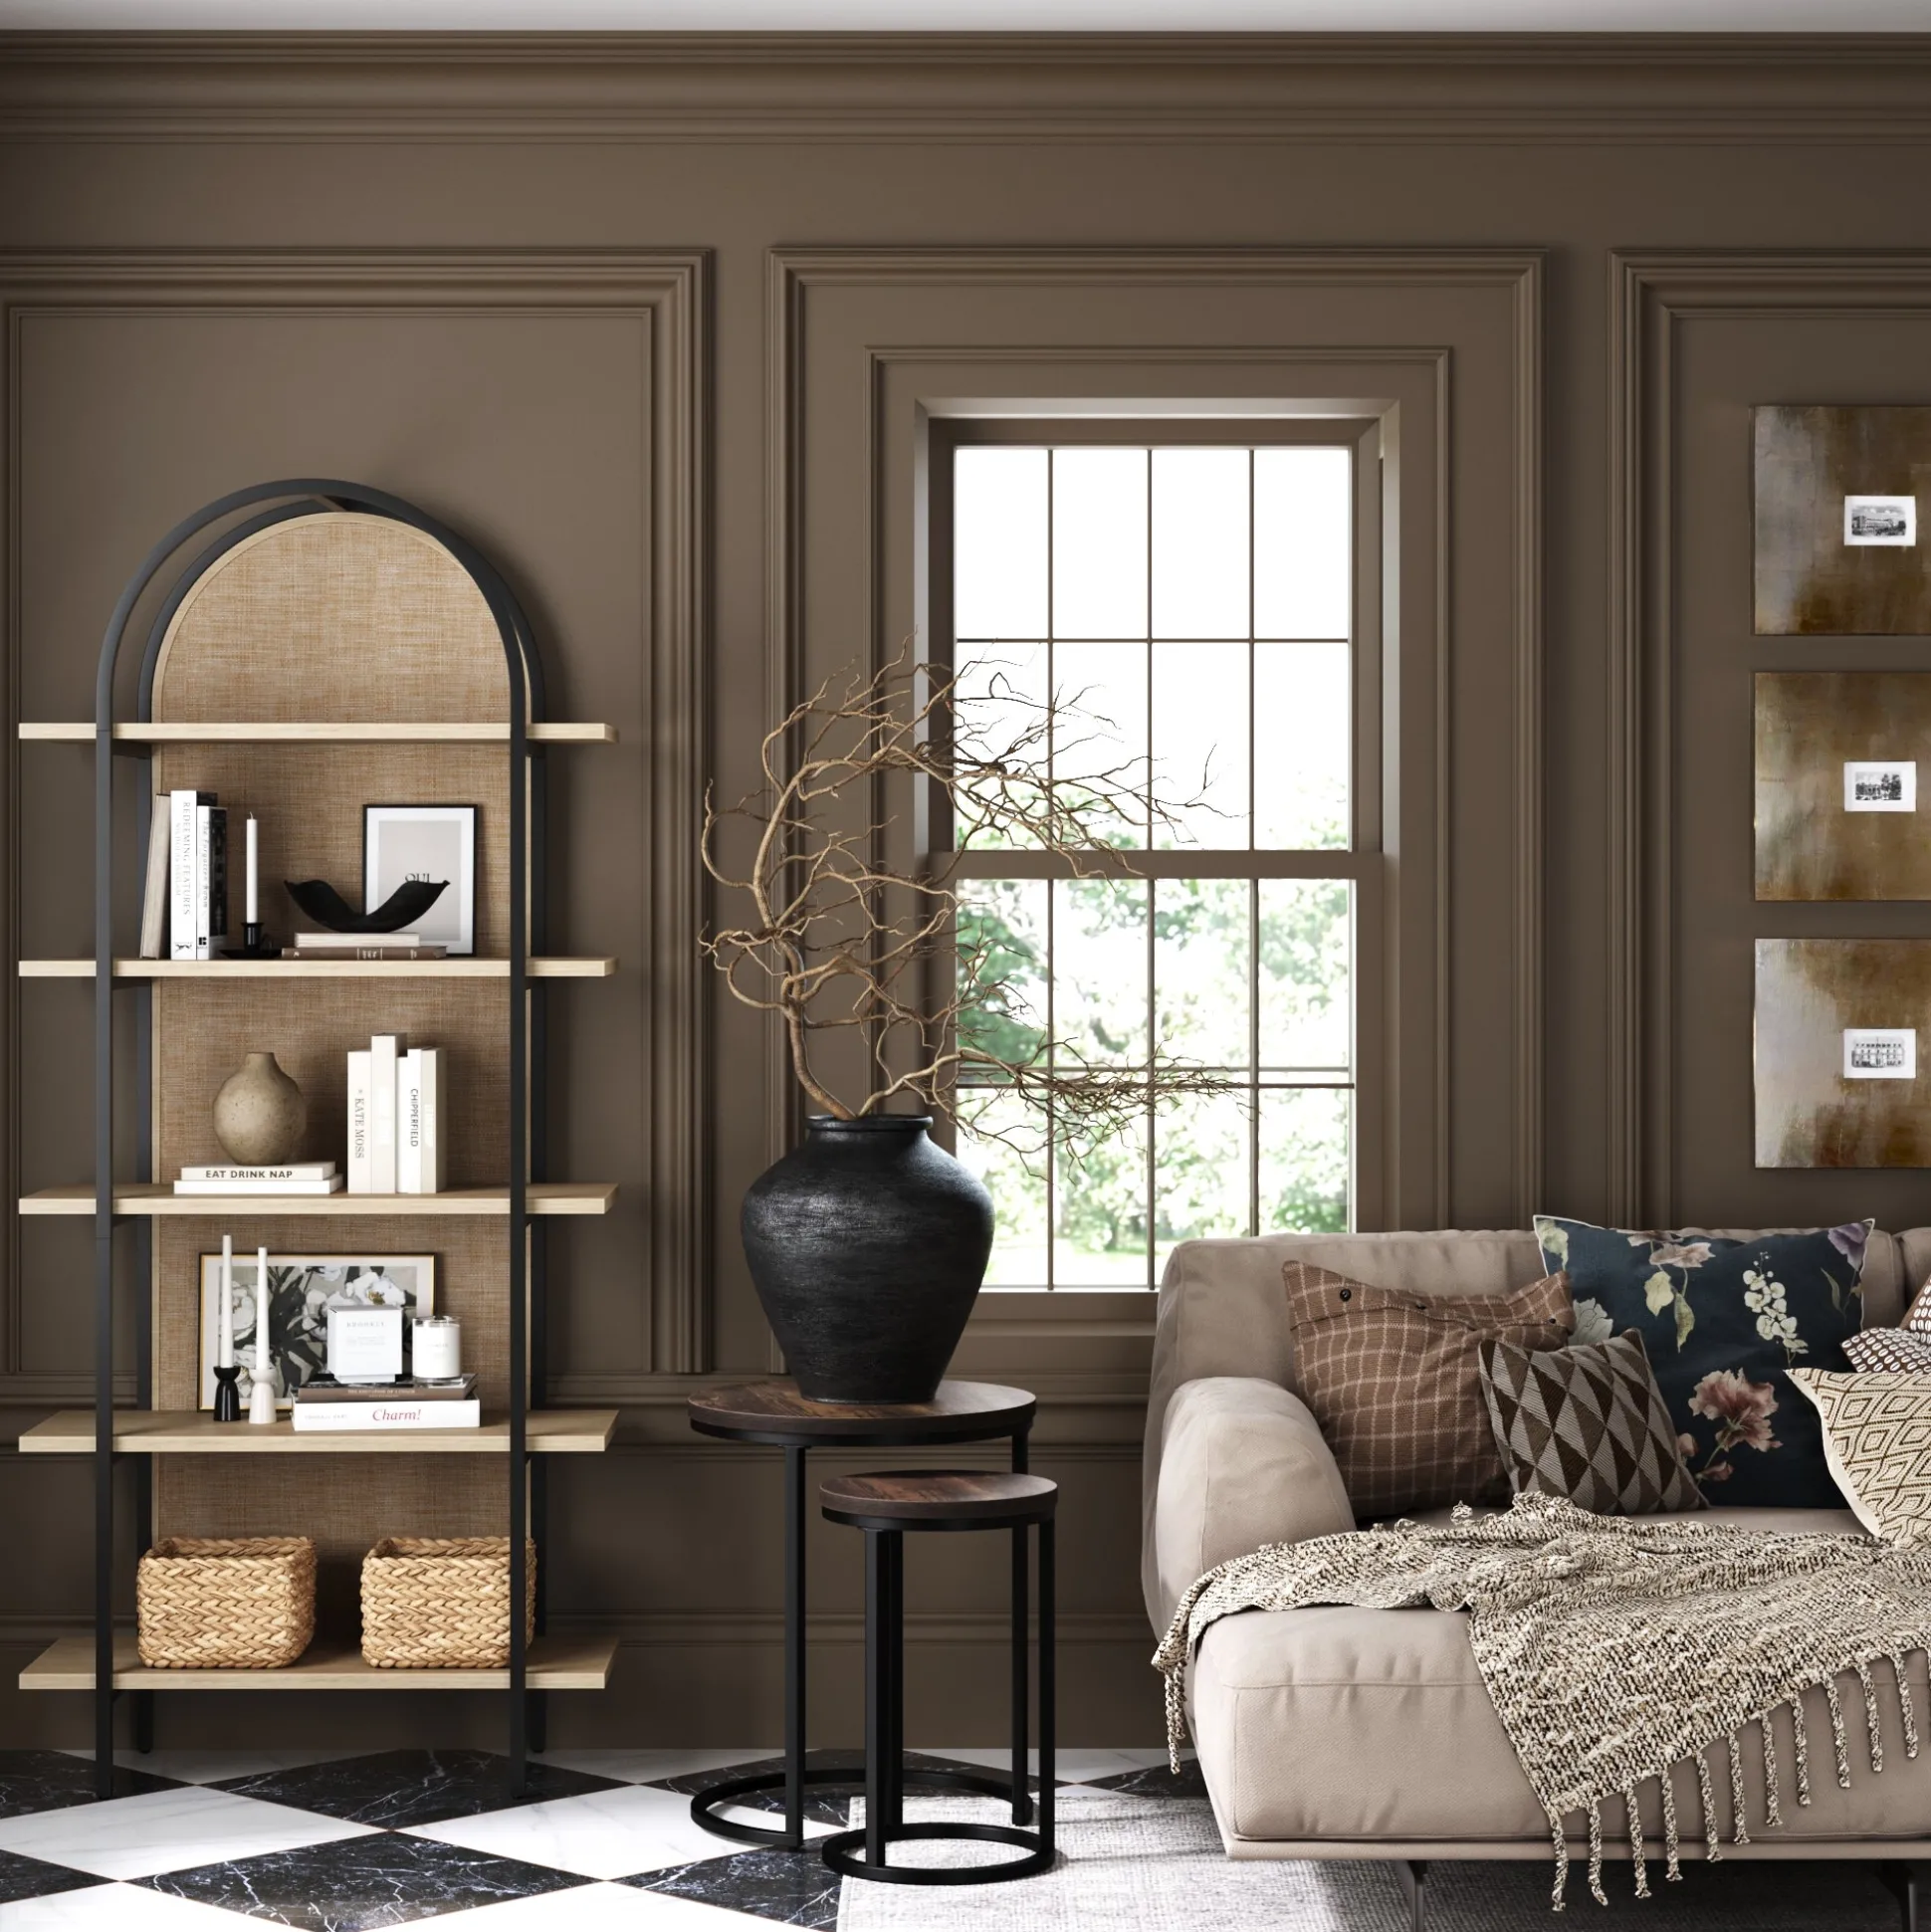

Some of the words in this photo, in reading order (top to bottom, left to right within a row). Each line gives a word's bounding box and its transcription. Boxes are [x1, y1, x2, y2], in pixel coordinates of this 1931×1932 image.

[182, 801, 191, 861] REDEEMING
[182, 864, 191, 916] FEATURES
[354, 1098, 364, 1127] KATE
[410, 1088, 419, 1148] CHIPPERFIELD
[354, 1129, 364, 1159] MOSS
[205, 1170, 226, 1179] EAT
[230, 1170, 266, 1179] DRINK
[269, 1170, 293, 1179] NAP
[371, 1408, 422, 1422] Charm!
